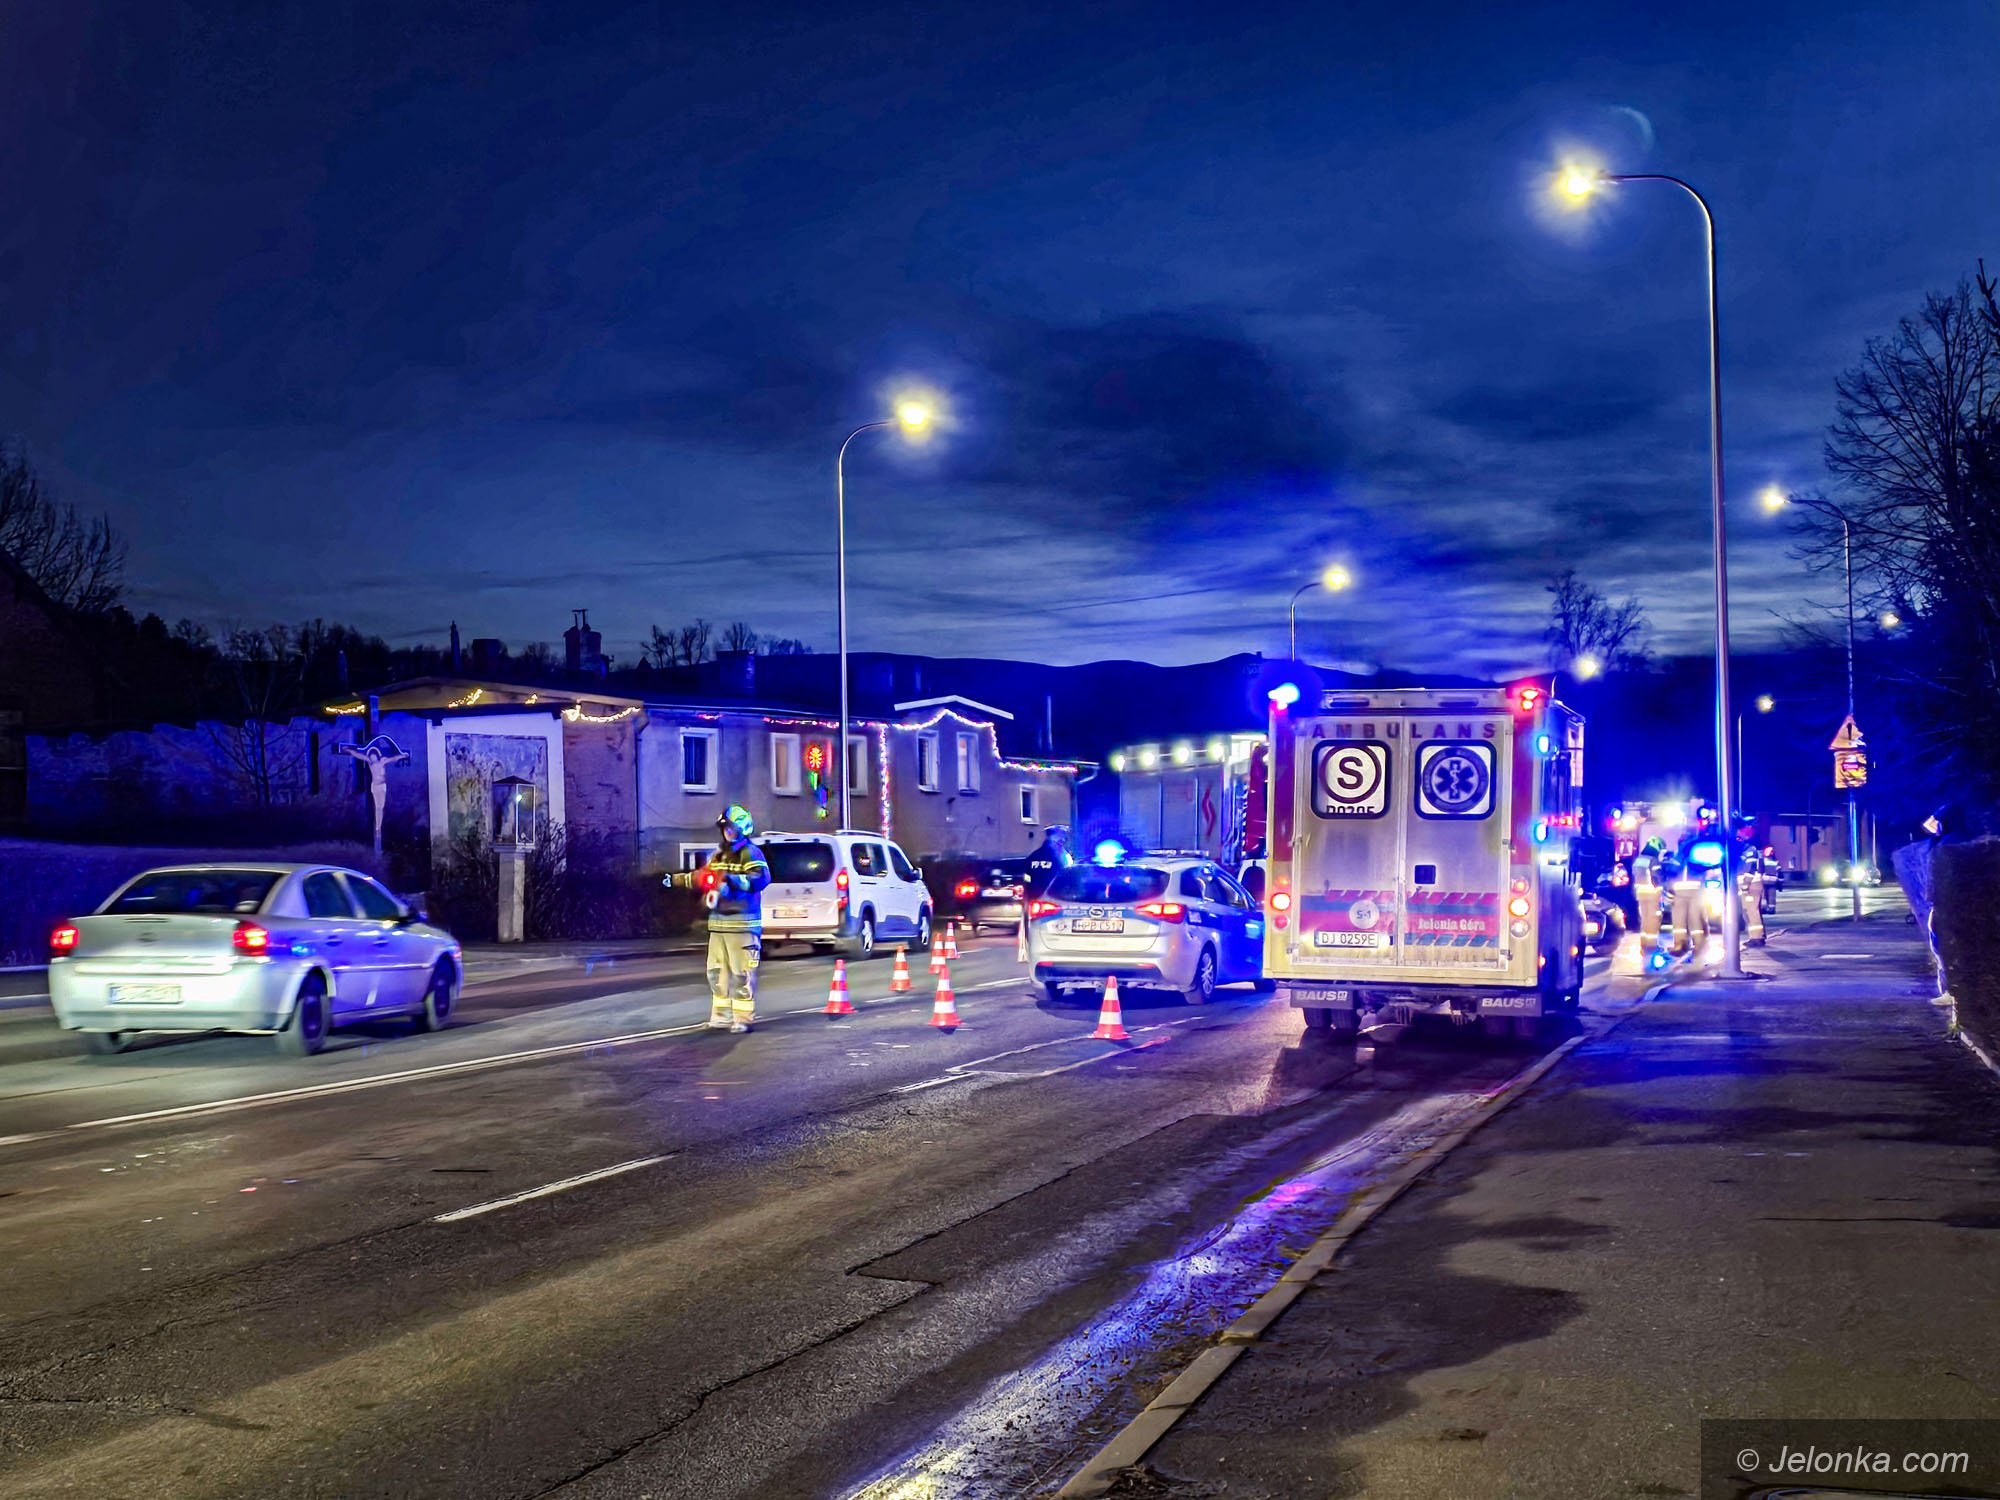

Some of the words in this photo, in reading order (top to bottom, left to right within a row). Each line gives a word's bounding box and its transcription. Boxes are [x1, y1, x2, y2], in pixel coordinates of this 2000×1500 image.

[1312, 723, 1496, 739] AMBULANS
[1337, 756, 1364, 790] S
[1356, 910, 1371, 919] S-1
[1321, 932, 1335, 944] DJ
[1340, 932, 1376, 945] 0259E
[1296, 991, 1337, 1001] BAUS
[1482, 998, 1524, 1008] BAUS
